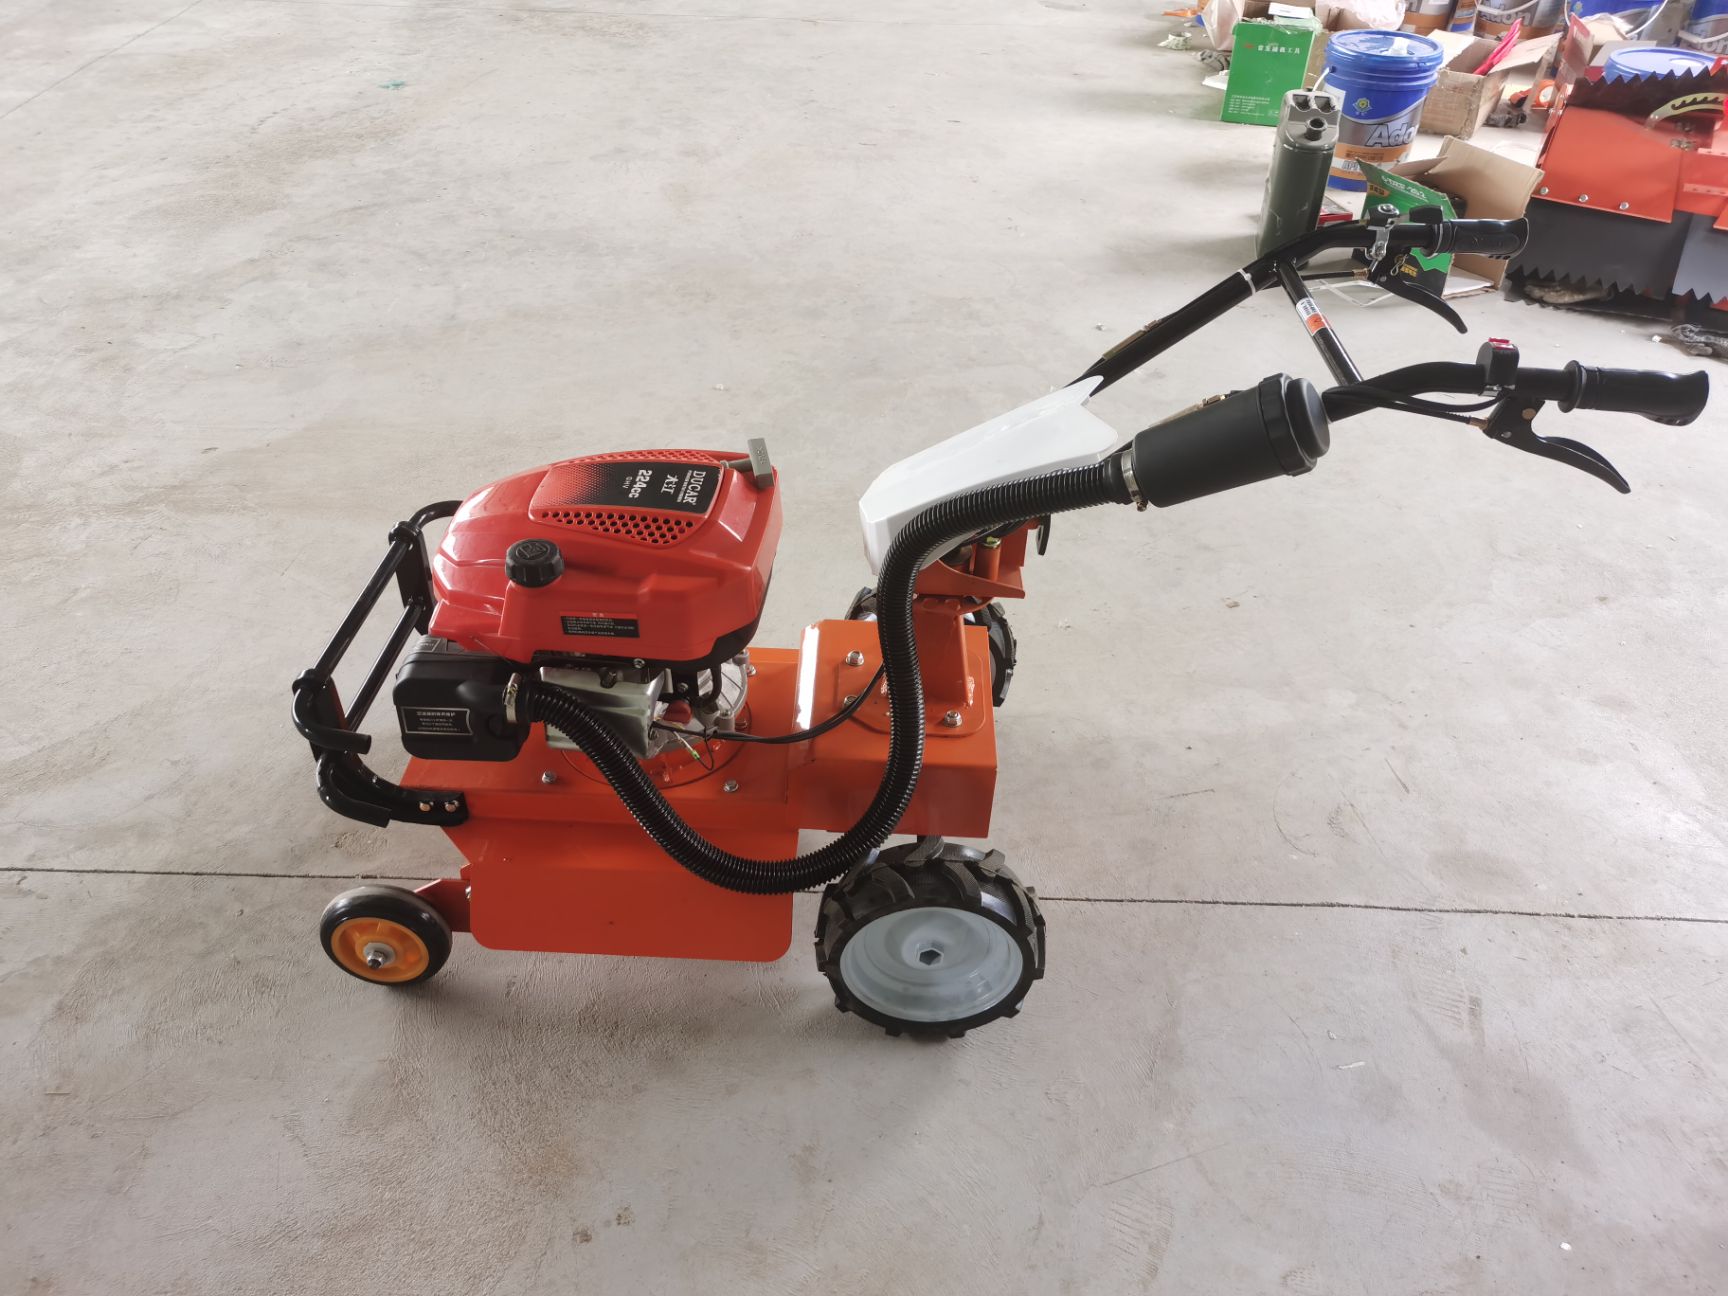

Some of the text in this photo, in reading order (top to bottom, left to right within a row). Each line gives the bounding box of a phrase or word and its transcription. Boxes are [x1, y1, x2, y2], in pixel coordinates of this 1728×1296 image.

[1365, 123, 1416, 148] Ado
[629, 469, 653, 498] 224cc
[684, 471, 706, 505] DUCAR
